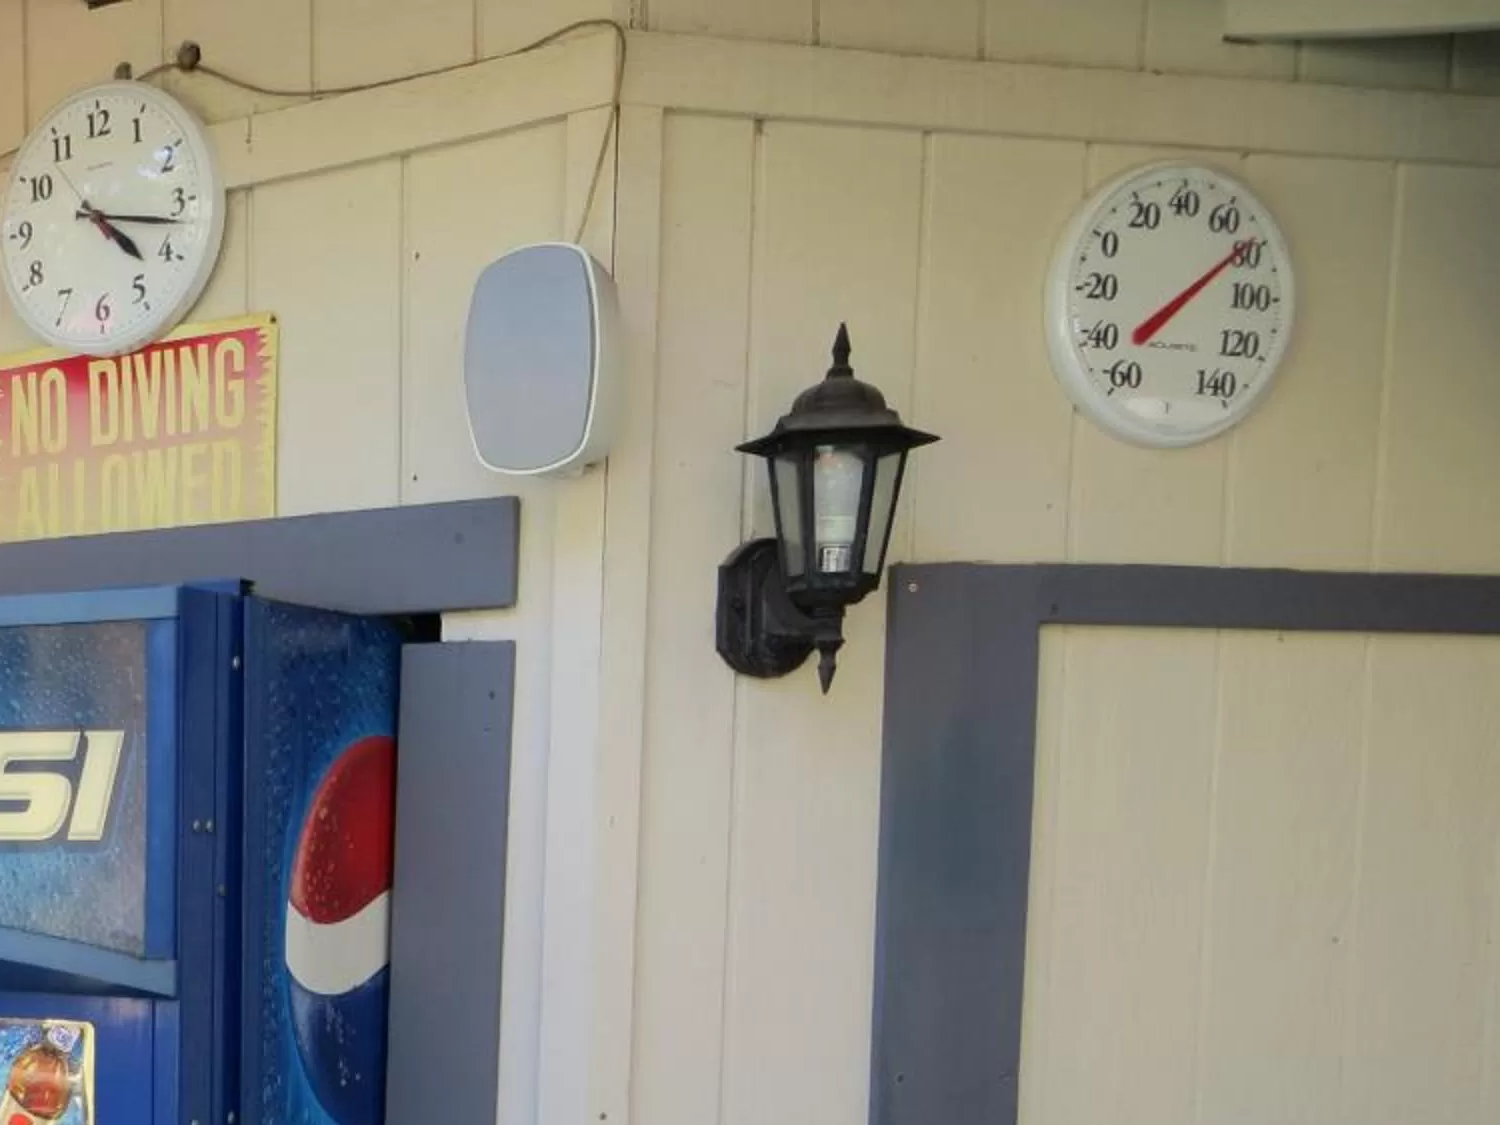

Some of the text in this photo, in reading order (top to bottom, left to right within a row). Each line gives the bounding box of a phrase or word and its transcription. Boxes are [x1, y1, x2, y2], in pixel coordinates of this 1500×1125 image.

[87, 109, 111, 139] 12
[132, 117, 142, 143] 1
[53, 134, 73, 163] 11
[161, 145, 173, 172] 2
[31, 174, 52, 203] 10
[170, 187, 185, 216] 3
[1168, 187, 1200, 216] 40
[1128, 201, 1161, 229] 20
[1209, 203, 1240, 234] 60
[19, 221, 32, 250] 9
[158, 232, 173, 262] 4
[1102, 231, 1118, 257] 0
[1231, 238, 1261, 269] 80
[29, 260, 43, 286] 8
[132, 273, 145, 304] 5
[1231, 282, 1271, 311] 100
[58, 288, 72, 319] 7
[95, 293, 110, 321] 6
[1220, 329, 1259, 359] 120
[10, 337, 245, 457] NO DIVING
[1196, 368, 1236, 398] 140
[17, 438, 242, 539] ALLOWED
